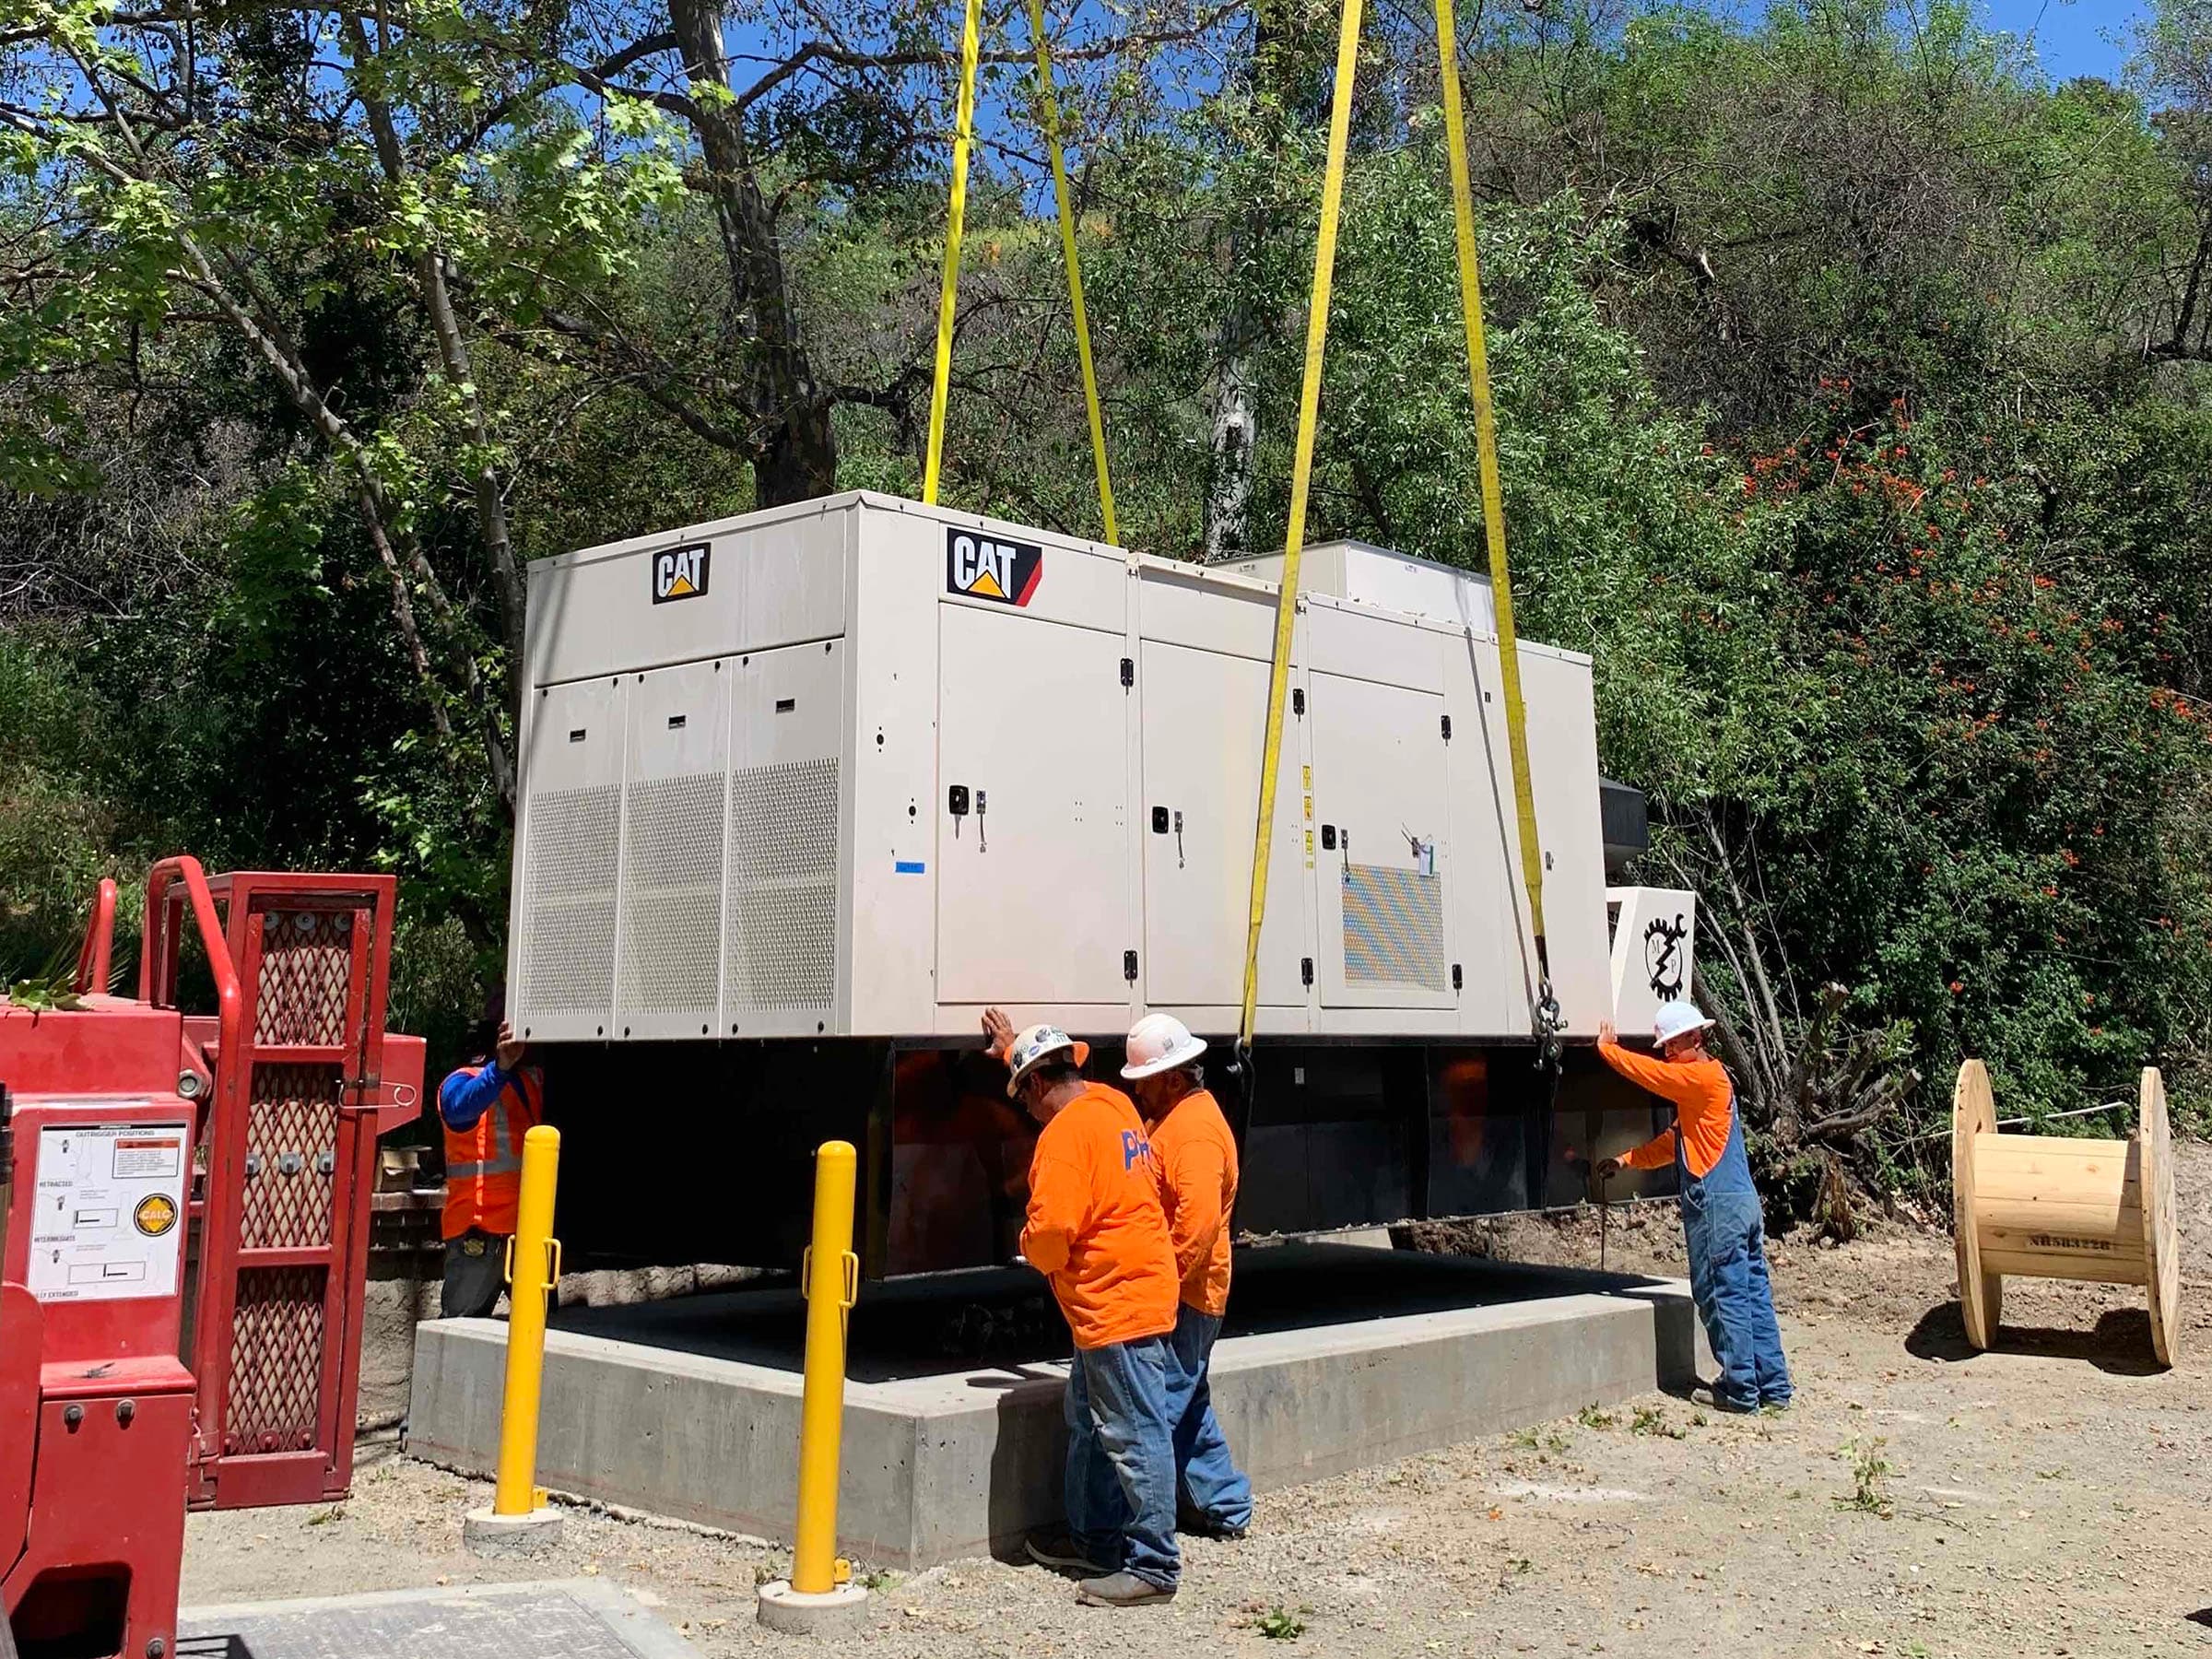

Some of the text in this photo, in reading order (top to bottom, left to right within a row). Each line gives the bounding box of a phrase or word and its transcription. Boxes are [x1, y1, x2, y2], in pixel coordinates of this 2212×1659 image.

[657, 547, 705, 598] CAT
[953, 535, 1017, 599] CAT
[118, 1129, 156, 1137] POSITIONS
